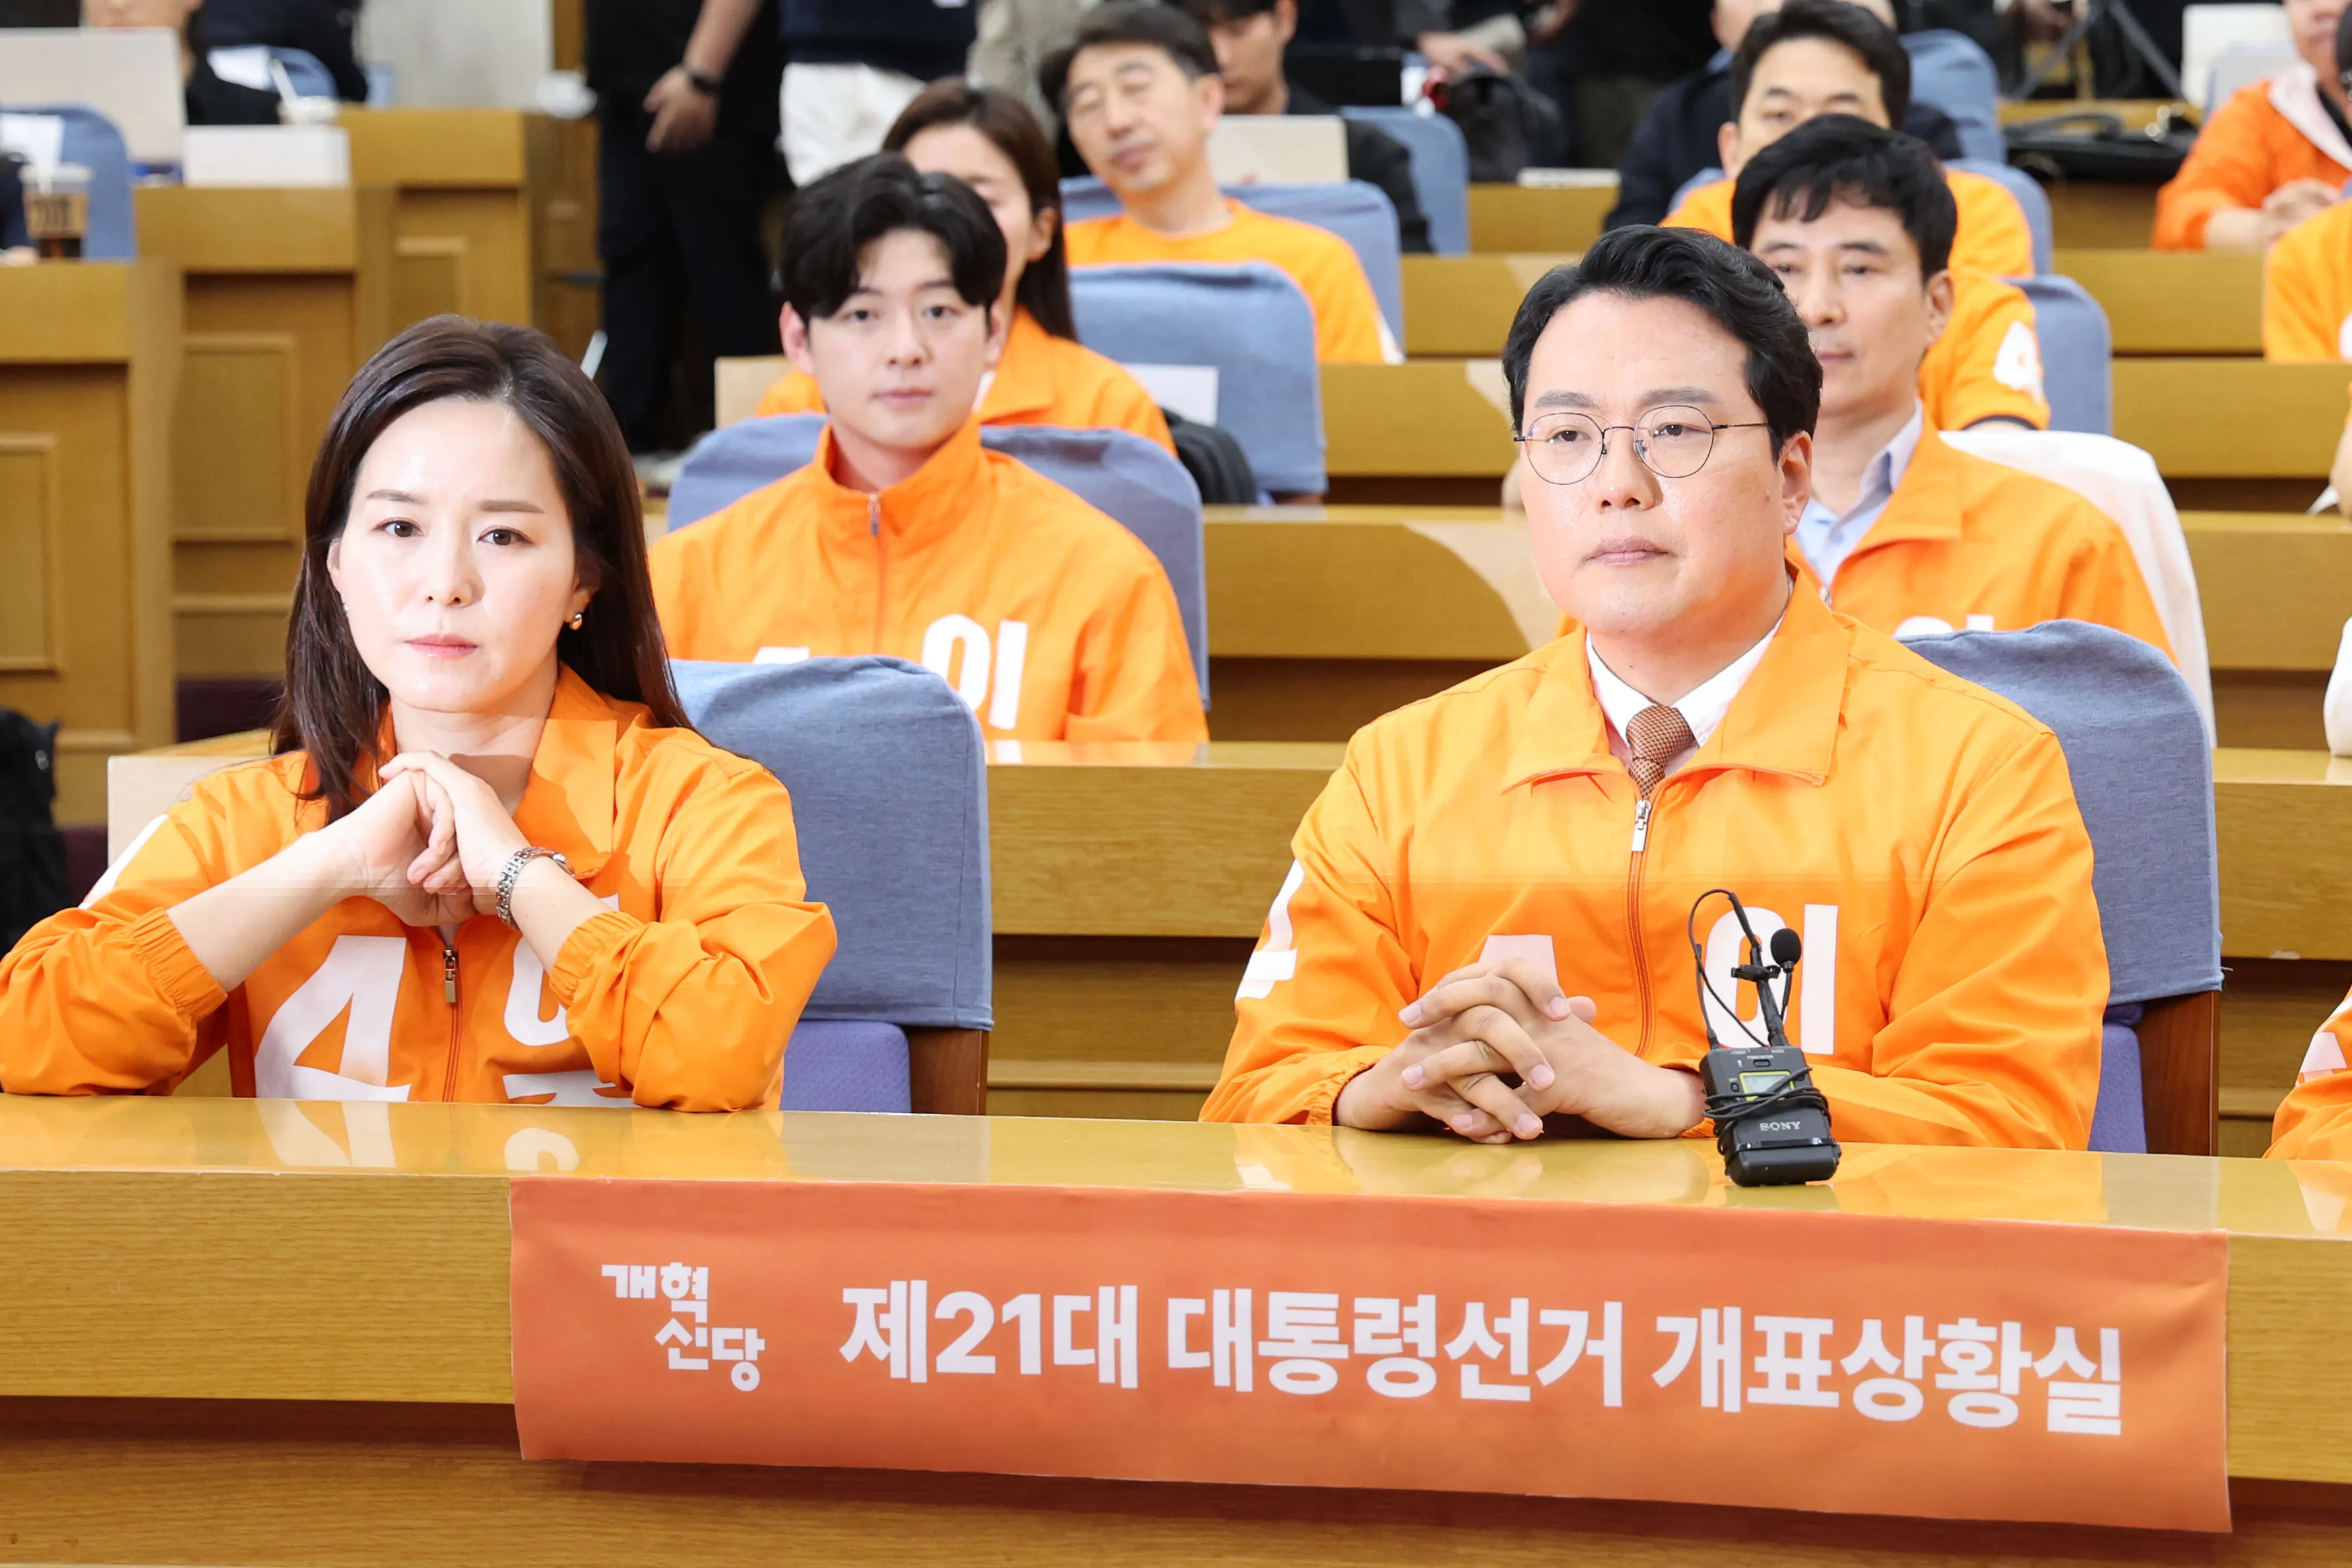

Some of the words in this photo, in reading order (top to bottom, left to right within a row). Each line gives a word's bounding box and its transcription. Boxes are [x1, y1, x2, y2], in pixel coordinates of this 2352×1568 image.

[255, 935, 412, 1102] 4
[1703, 904, 1839, 1055] 이
[1759, 1121, 1801, 1132] SONY
[601, 1261, 709, 1323] 개혁
[654, 1317, 765, 1392] 신당
[839, 1279, 1139, 1389] 제21대
[1167, 1288, 1623, 1408] 대통령선거
[1651, 1306, 2122, 1436] 개표상황실
